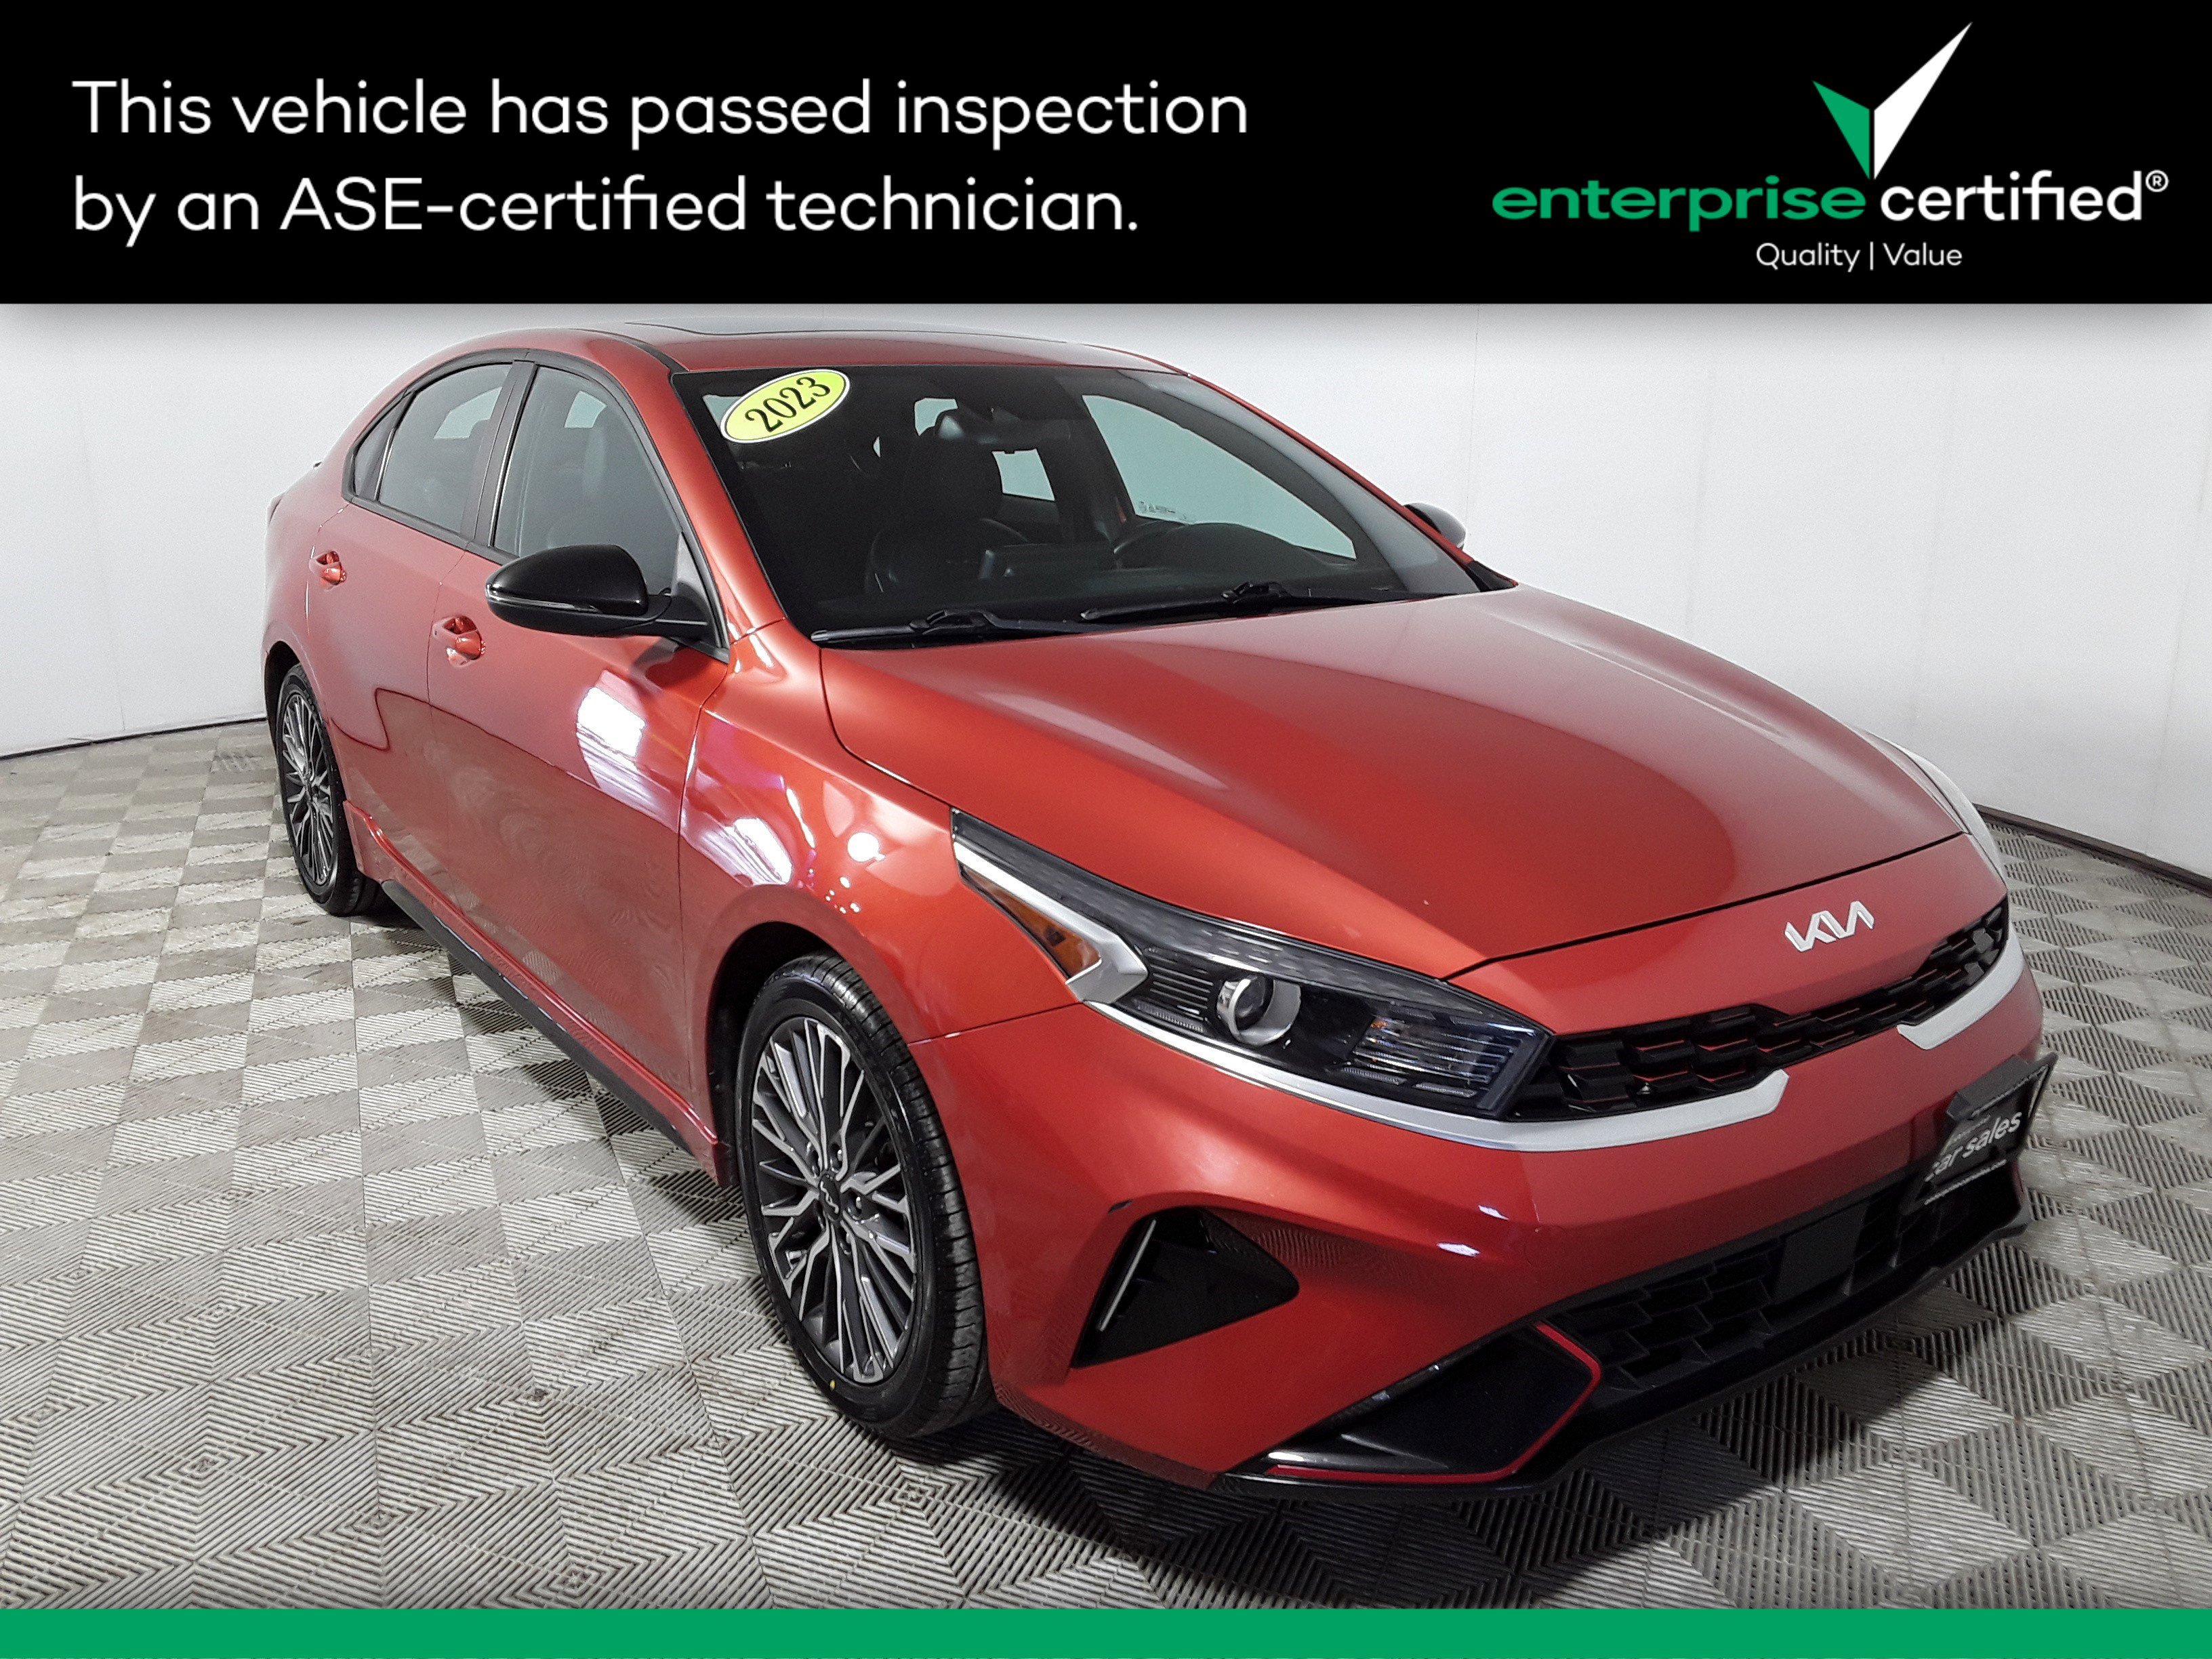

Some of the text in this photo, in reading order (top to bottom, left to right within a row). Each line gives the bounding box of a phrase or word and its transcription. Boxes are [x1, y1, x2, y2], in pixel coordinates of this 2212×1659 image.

[745, 377, 831, 432] 2023
[1785, 901, 1875, 952] KIA
[1962, 1112, 2022, 1158] sales
